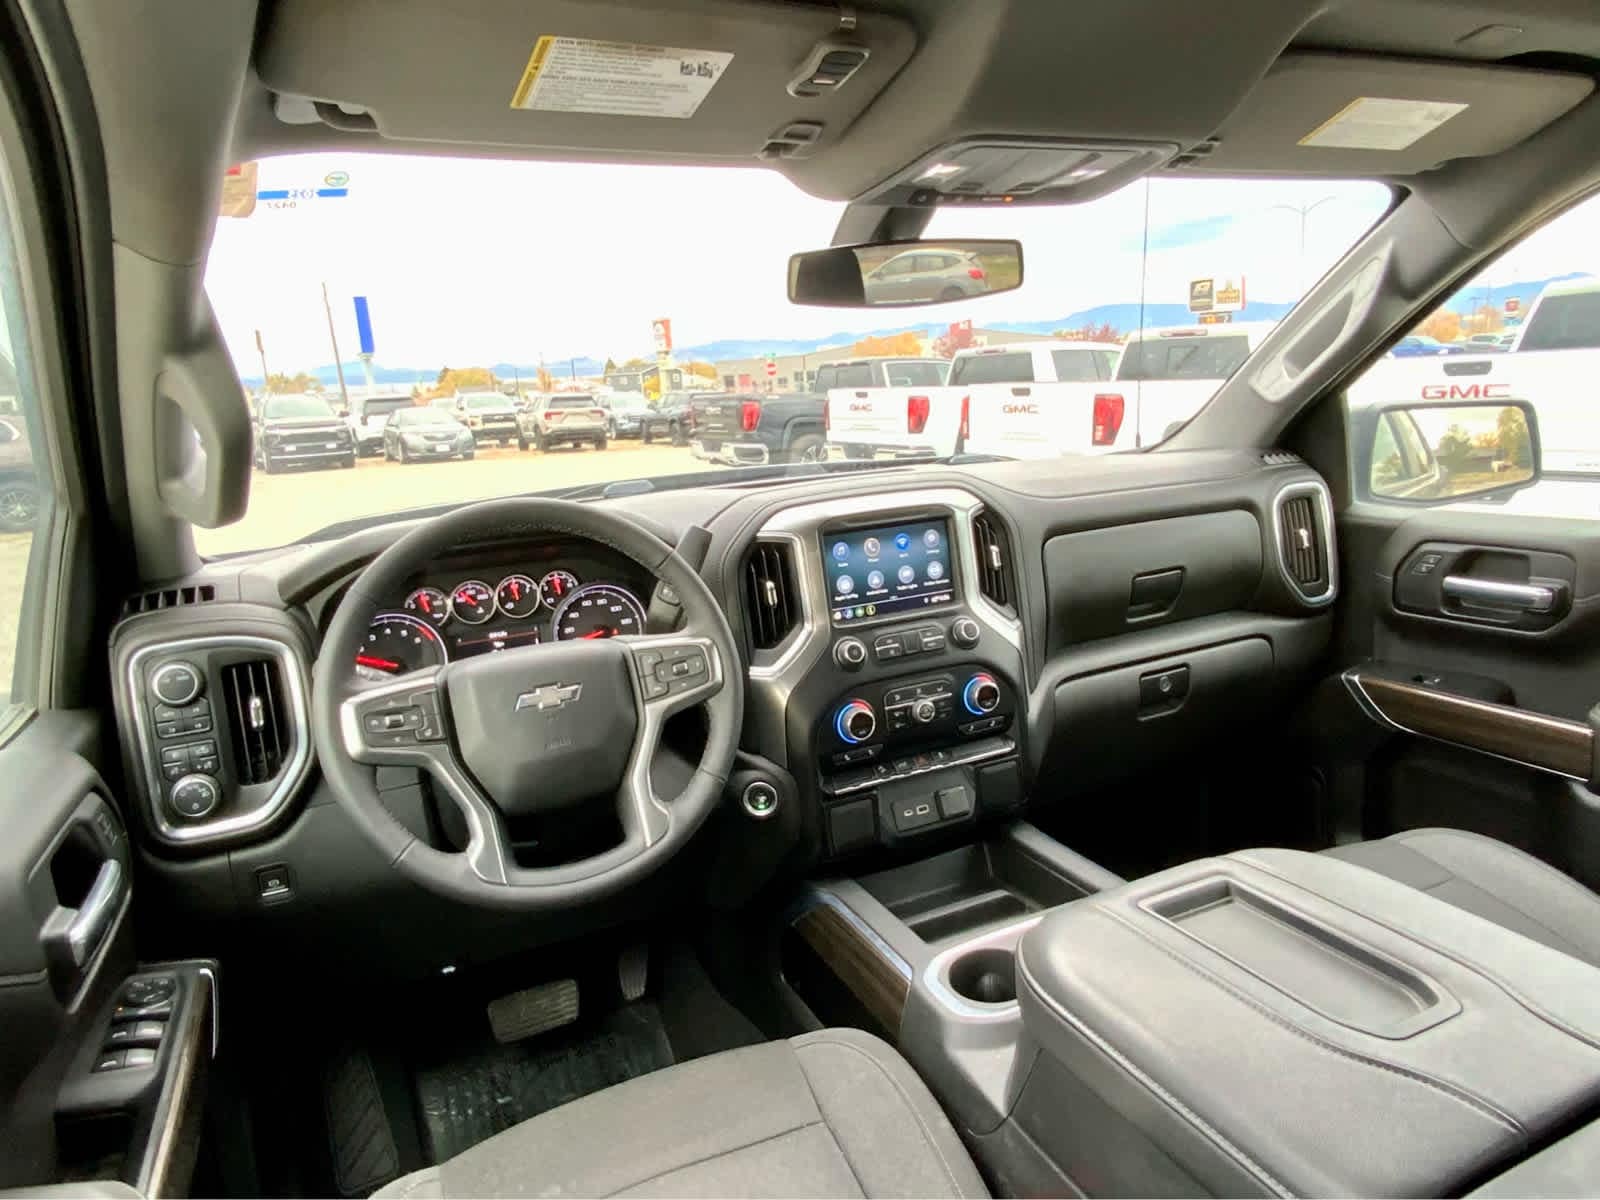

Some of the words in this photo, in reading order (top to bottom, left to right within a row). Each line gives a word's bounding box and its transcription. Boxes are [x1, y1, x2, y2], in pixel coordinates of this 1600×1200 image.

[1421, 383, 1511, 400] GMC
[849, 403, 873, 412] GMC
[1002, 404, 1040, 415] GMC
